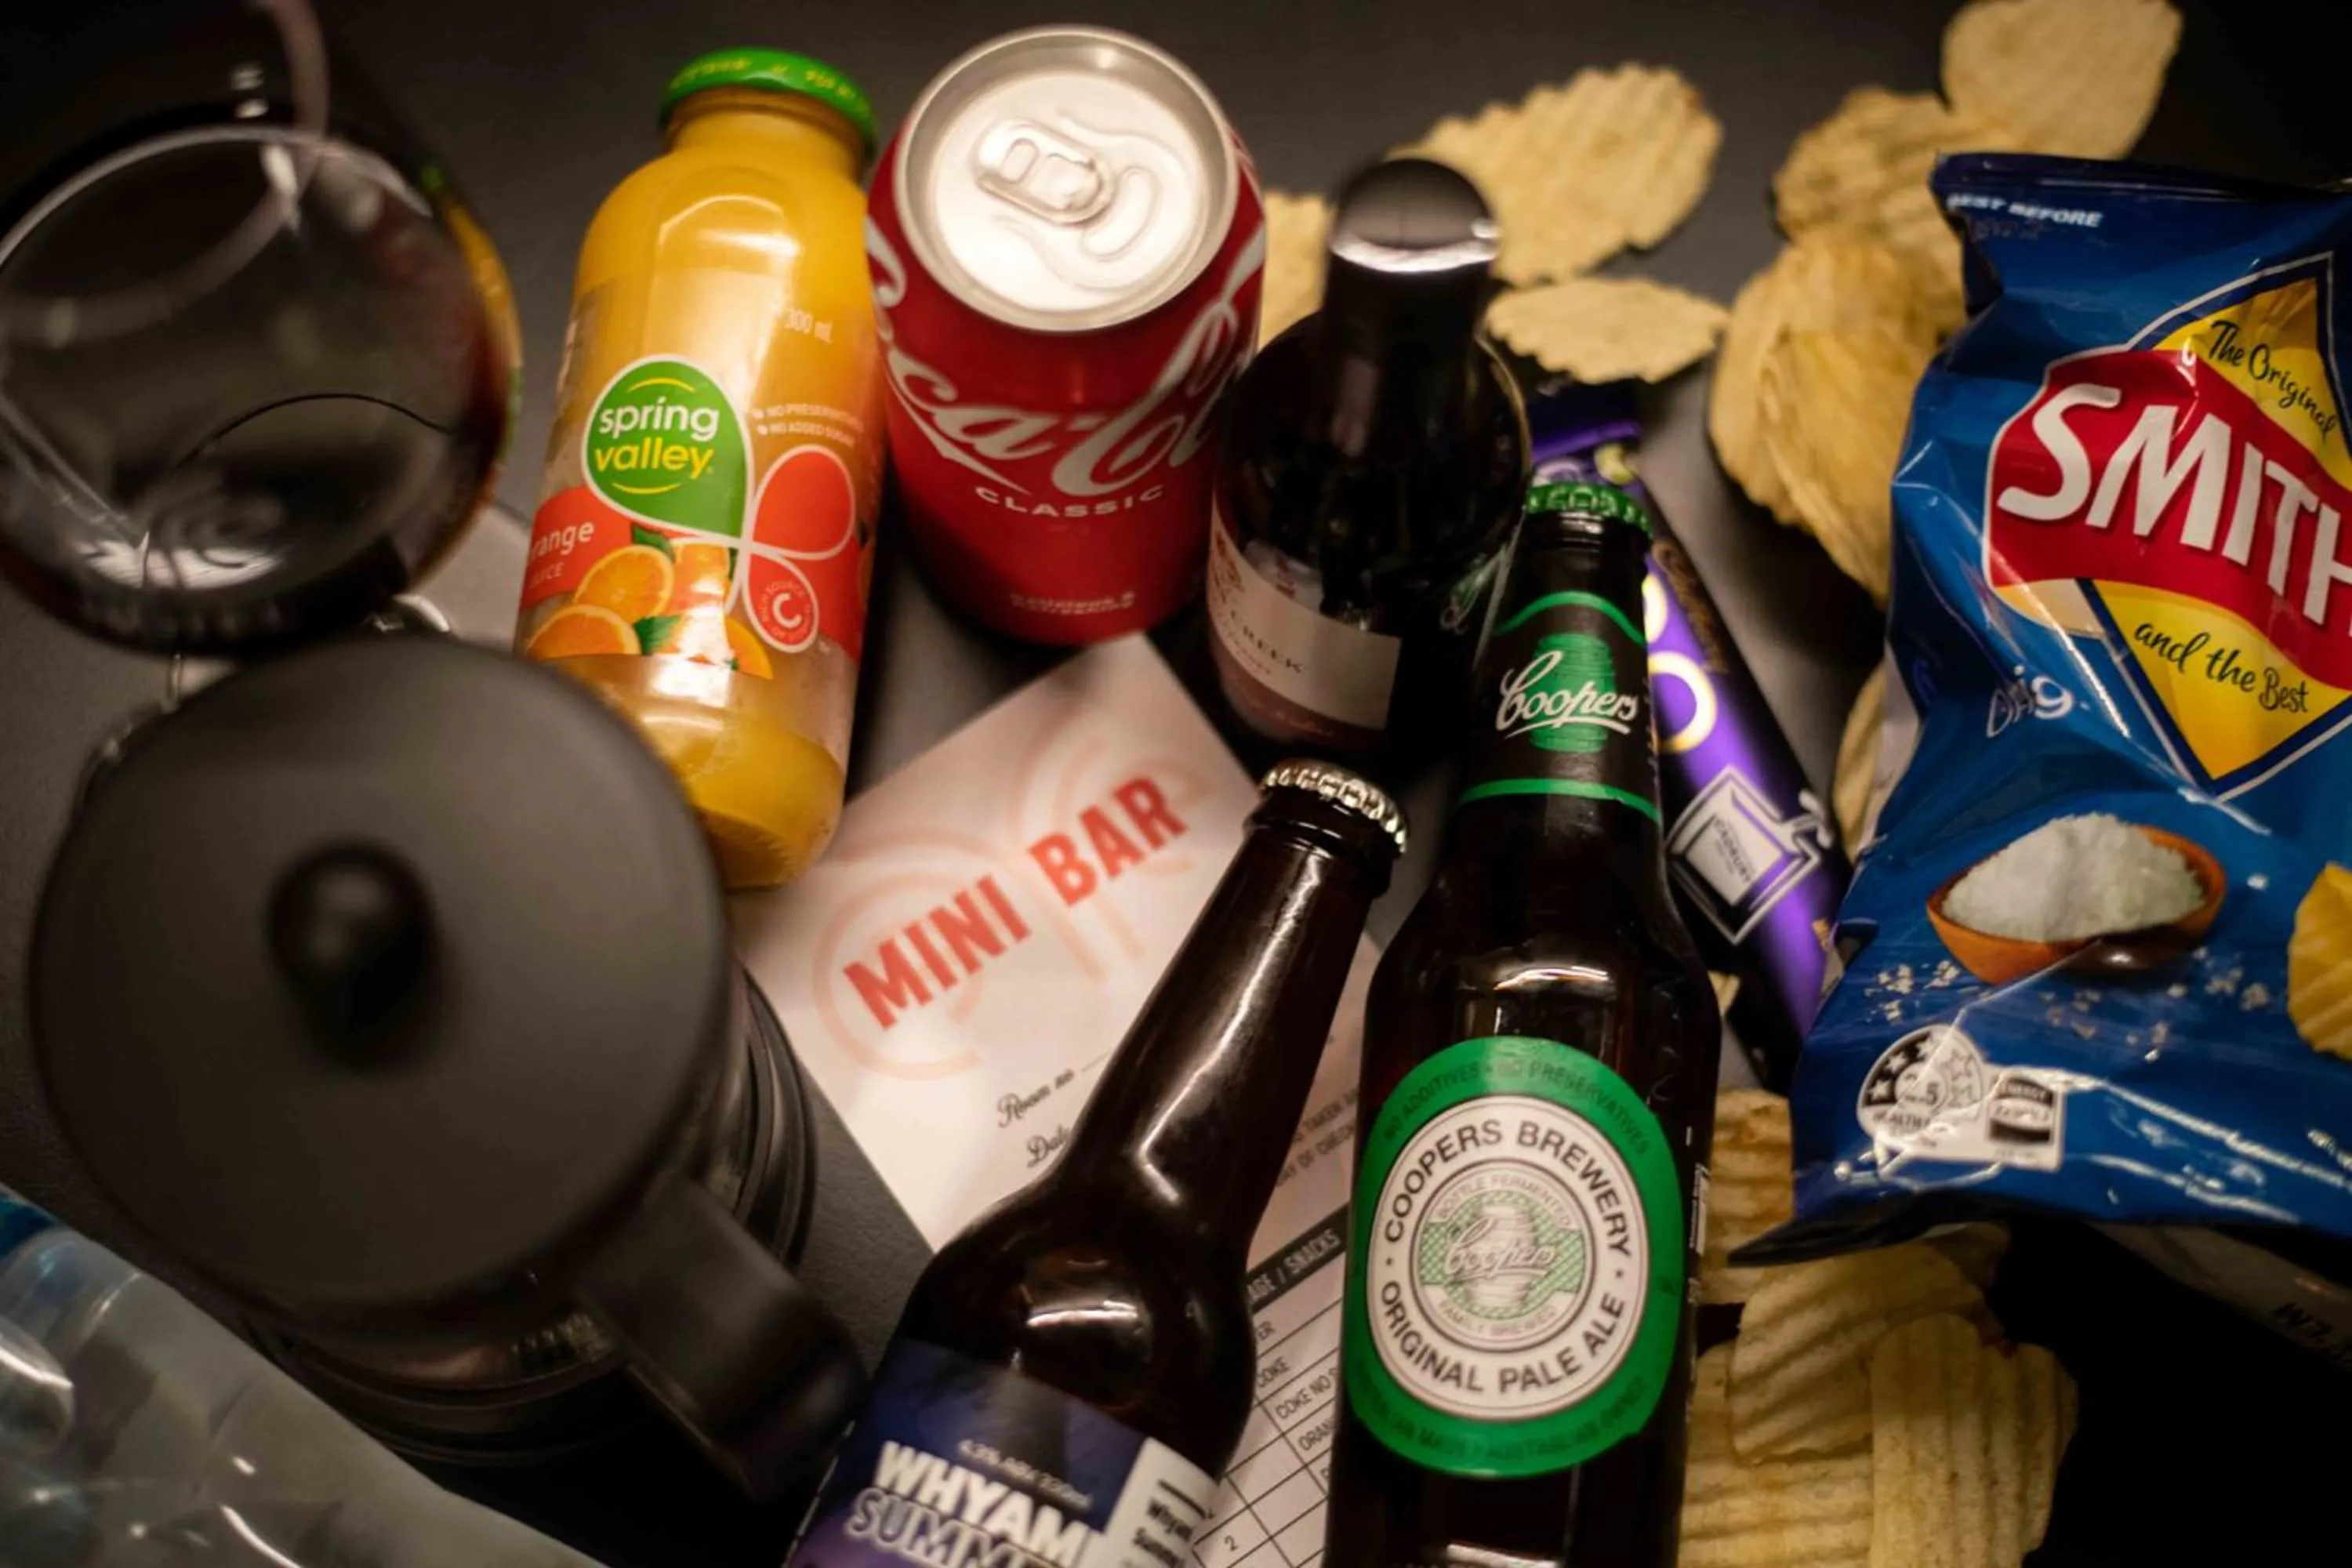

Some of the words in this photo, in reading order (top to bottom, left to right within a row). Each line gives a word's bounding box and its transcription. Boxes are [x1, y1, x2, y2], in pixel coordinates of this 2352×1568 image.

[2008, 201, 2104, 228] BEFORE
[597, 396, 720, 441] spring
[2209, 319, 2245, 368] The
[2248, 343, 2338, 443] Original
[594, 437, 712, 479] valley
[975, 485, 1166, 519] CLASSIC
[1495, 650, 1639, 737] Coopers
[2132, 622, 2211, 674] and
[2205, 641, 2256, 695] the
[2258, 666, 2311, 715] Best
[843, 875, 1031, 1030] MINI
[1029, 775, 1188, 906] BAR
[1385, 1118, 1504, 1245] COOPERS
[1515, 1120, 1632, 1260] BREWERY
[1380, 1279, 1485, 1394] ORIGINAL
[1497, 1346, 1583, 1395] PALE
[1587, 1290, 1626, 1359] ALE
[1224, 1534, 1240, 1553] 2
